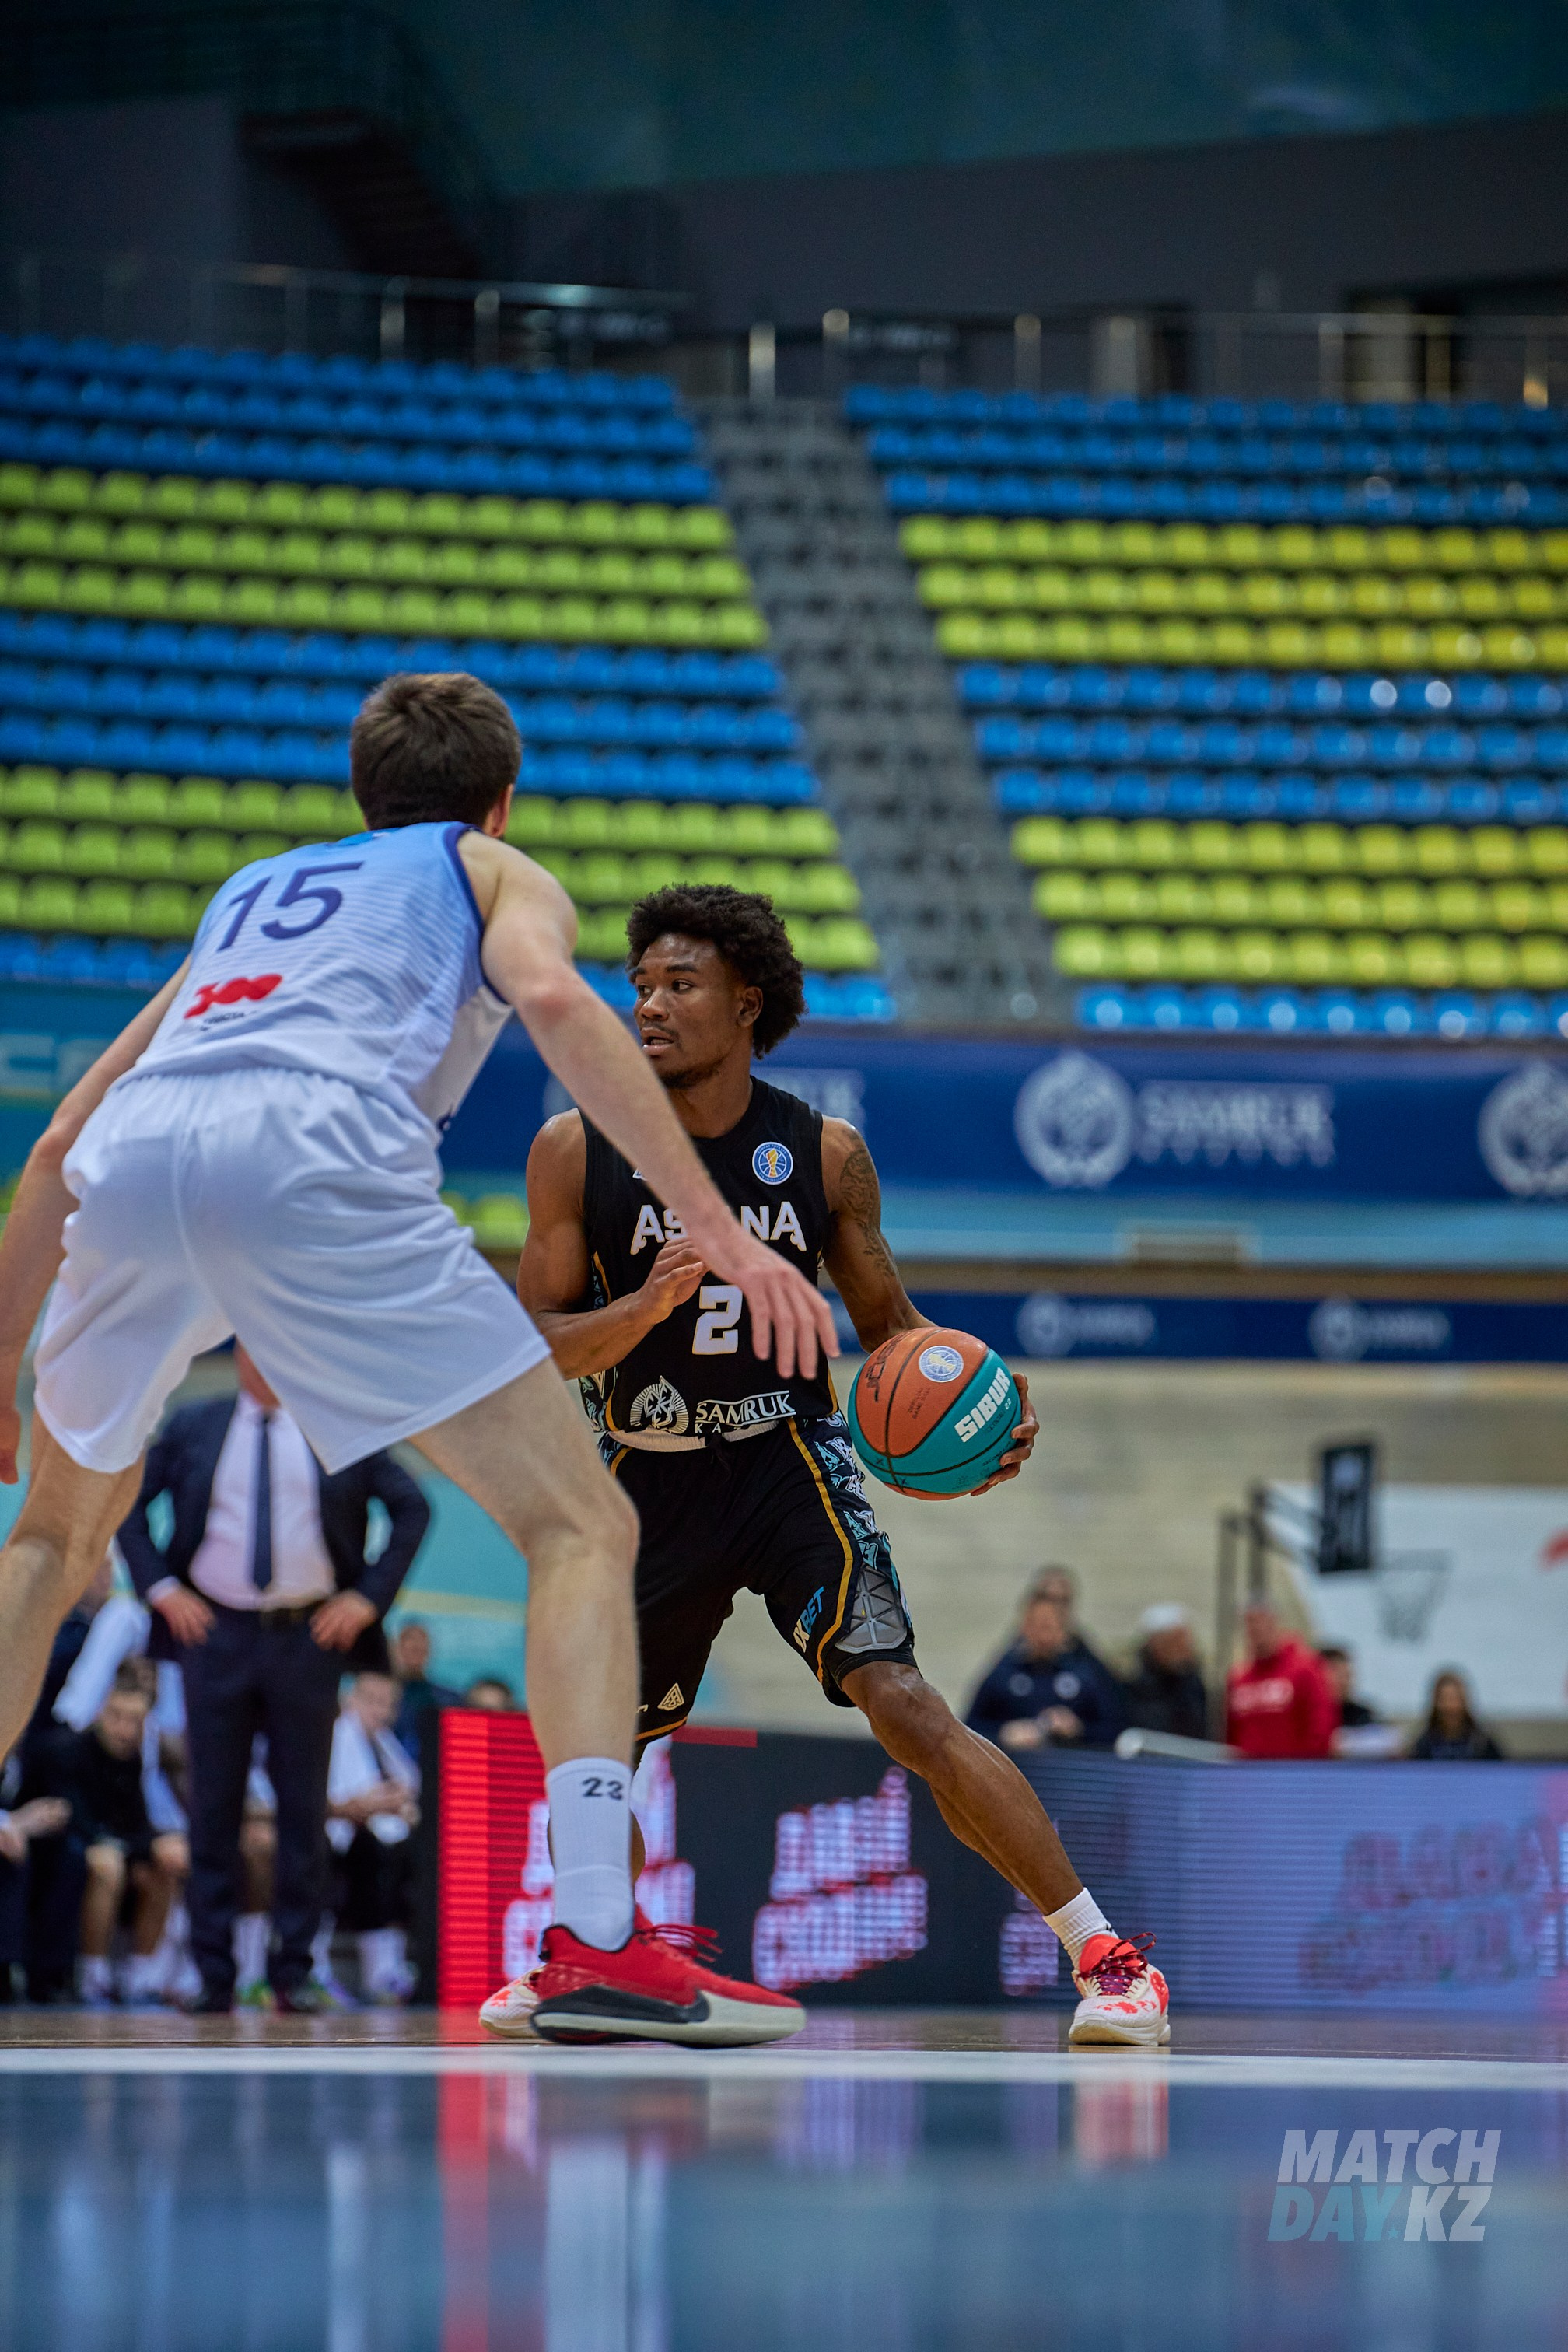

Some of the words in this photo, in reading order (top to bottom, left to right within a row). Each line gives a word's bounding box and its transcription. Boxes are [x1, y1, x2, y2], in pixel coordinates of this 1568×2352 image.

[216, 860, 365, 952] 15
[629, 1201, 807, 1255] ASNA
[691, 1284, 743, 1355] 2
[695, 1393, 796, 1426] SAMRUK
[954, 1367, 1011, 1443] SIBUR
[582, 1776, 625, 1801] 23
